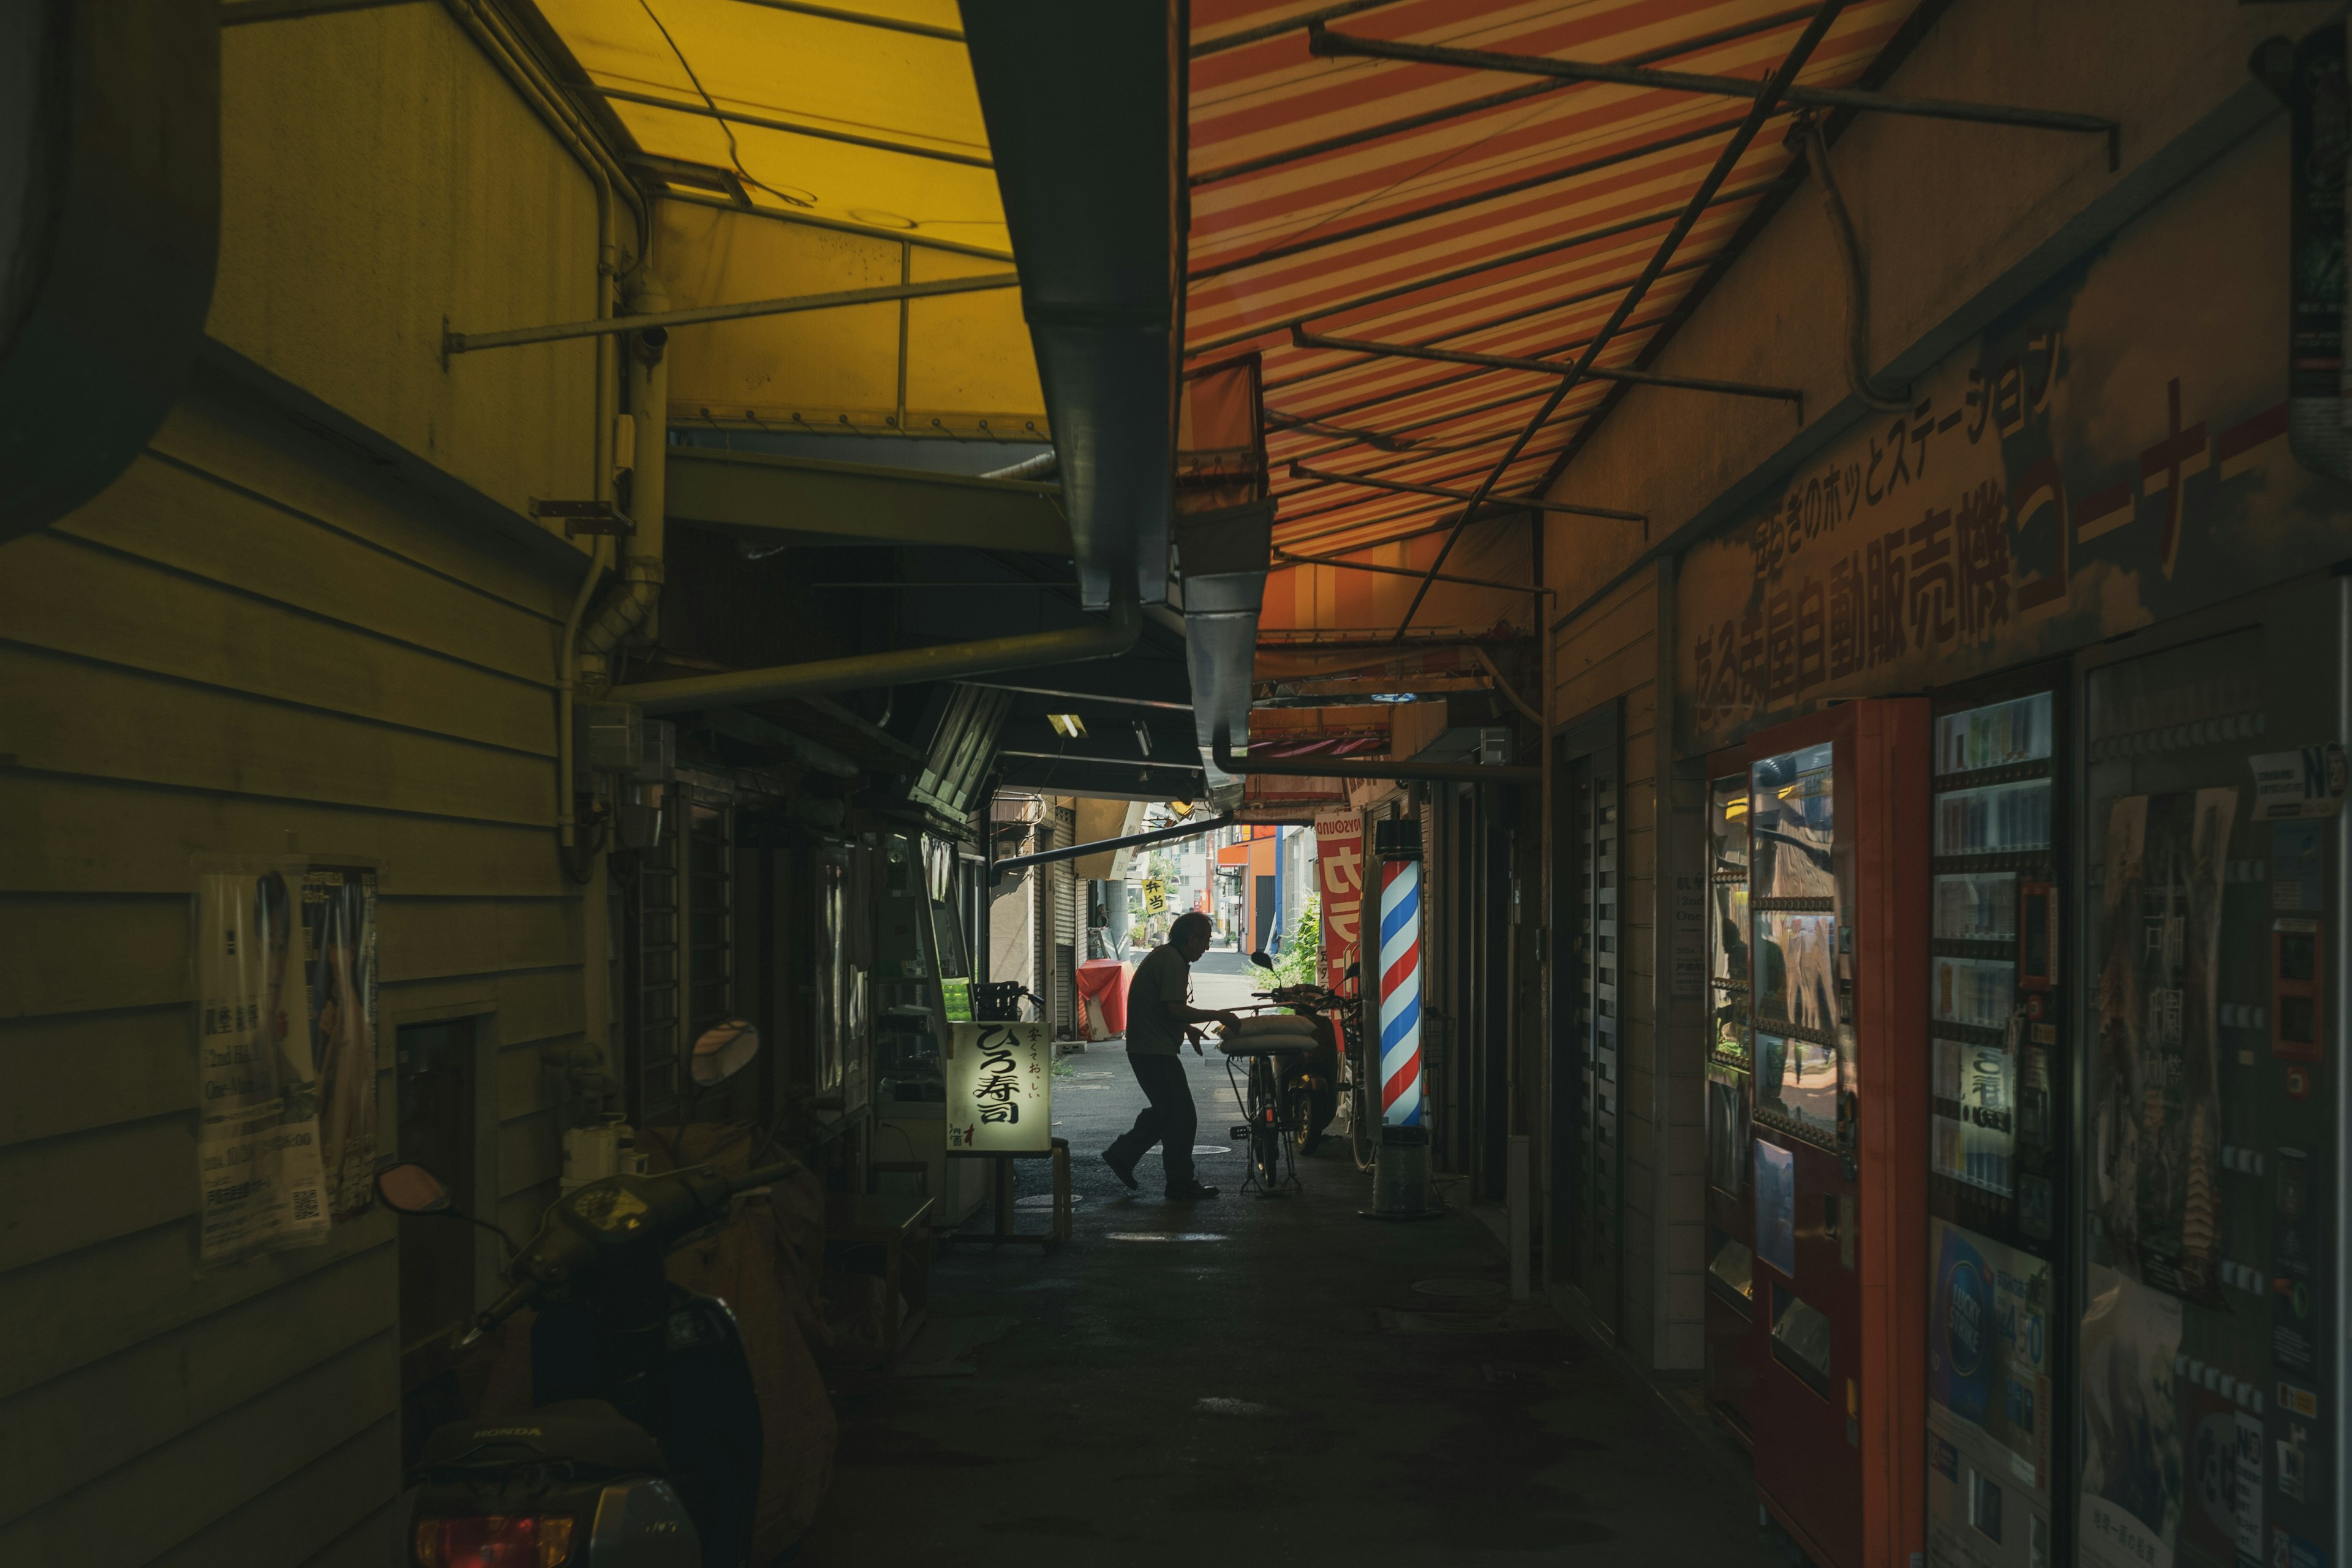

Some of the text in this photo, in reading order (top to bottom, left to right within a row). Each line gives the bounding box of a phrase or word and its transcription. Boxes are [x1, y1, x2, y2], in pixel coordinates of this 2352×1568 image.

[1145, 881, 1163, 910] 弁当
[973, 1023, 1020, 1125] ひろ寿司
[1950, 1305, 1981, 1355] STRIKE
[1952, 1283, 1981, 1330] LUCKY
[472, 1428, 543, 1439] HONDA
